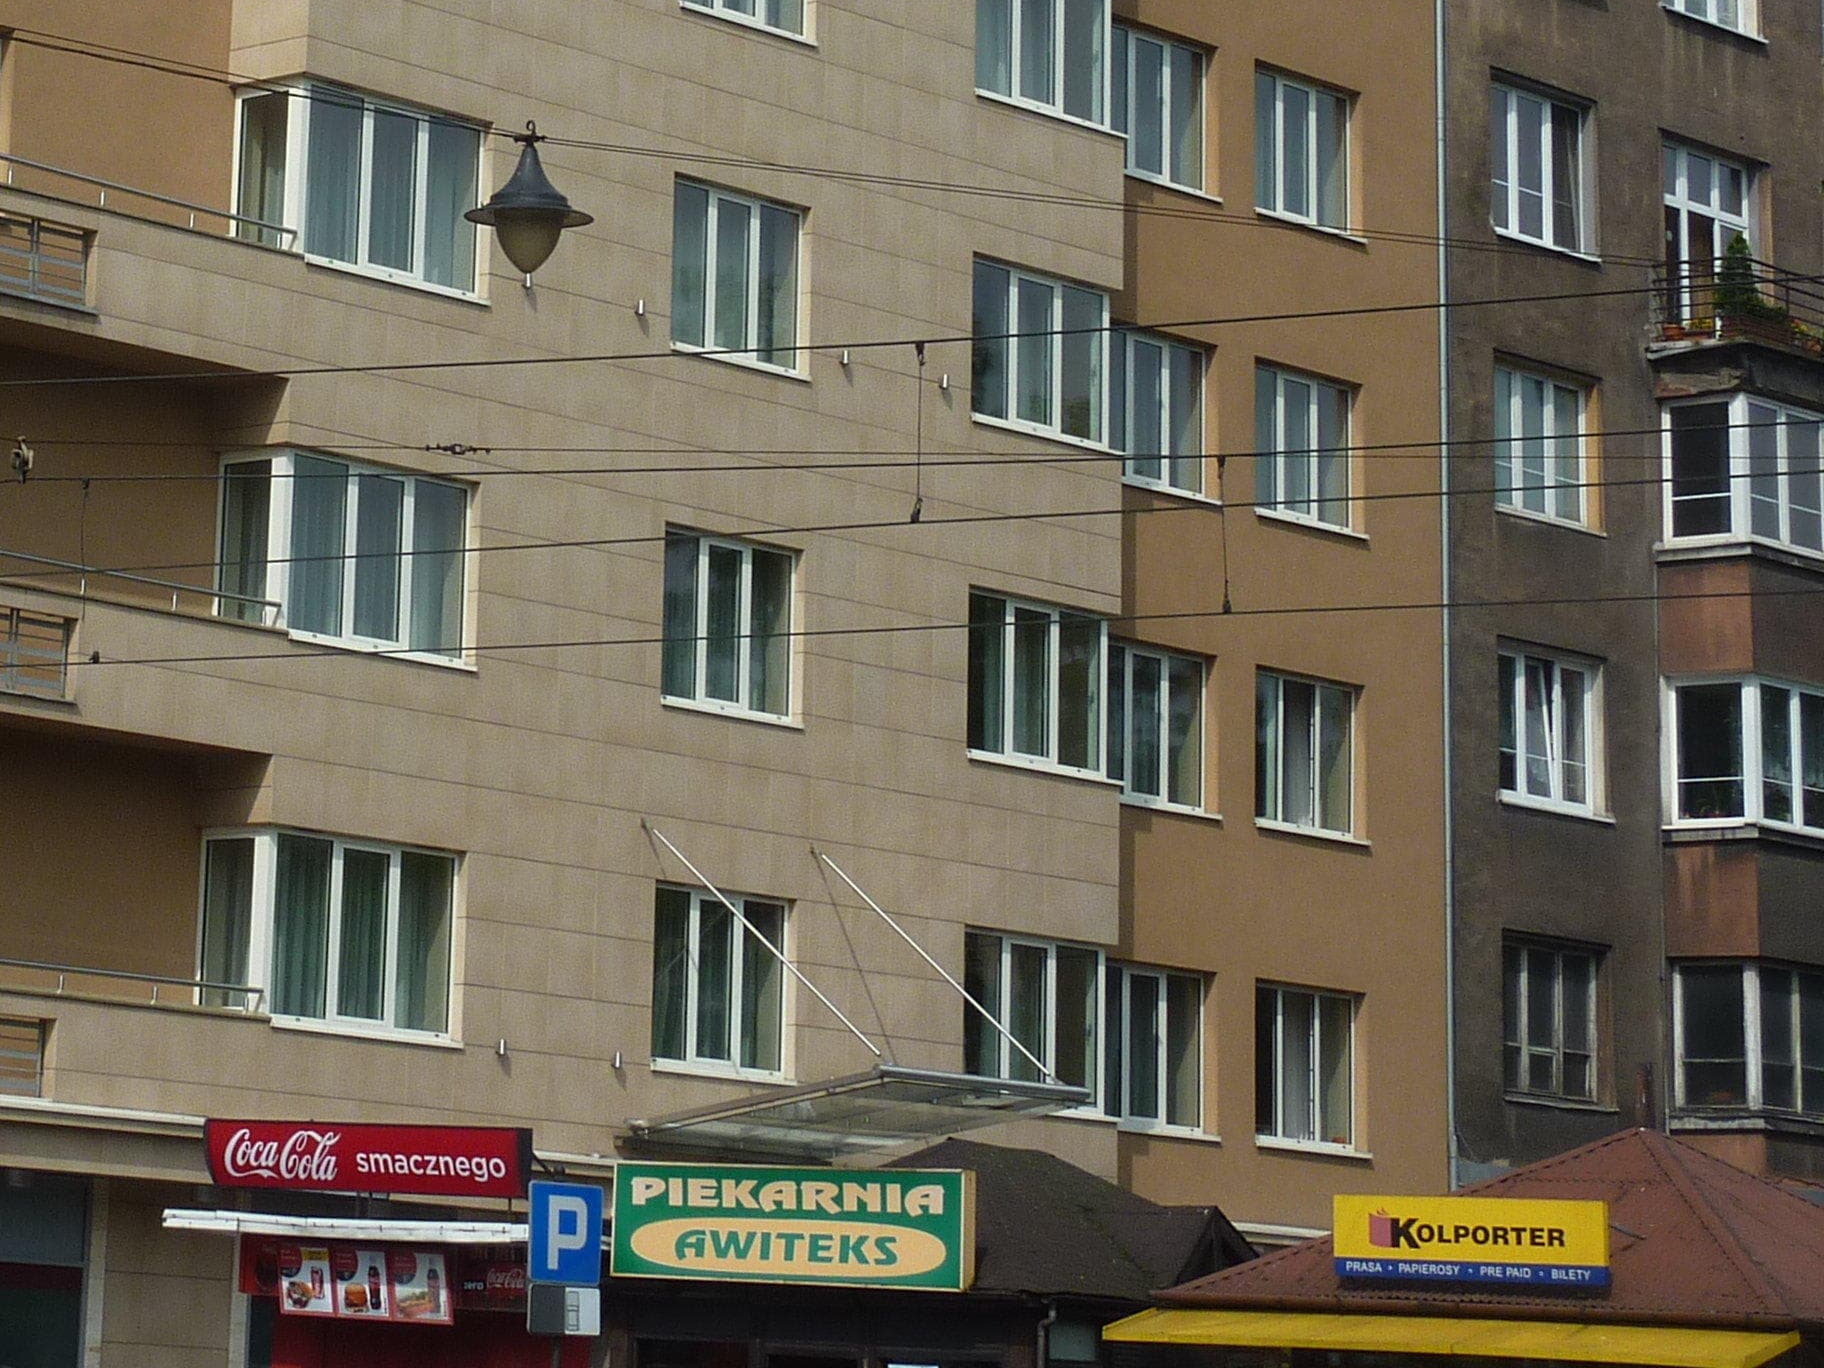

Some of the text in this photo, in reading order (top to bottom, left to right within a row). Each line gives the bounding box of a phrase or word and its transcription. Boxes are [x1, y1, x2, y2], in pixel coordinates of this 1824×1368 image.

[356, 1150, 507, 1183] smacznego
[631, 1176, 945, 1217] PIEKARNIA
[547, 1194, 588, 1270] P
[674, 1229, 899, 1267] AWITEKS
[1390, 1217, 1566, 1249] KOLPORTER
[1346, 1260, 1591, 1281] PRASA PAPIEROSY PRE PAID BILETY
